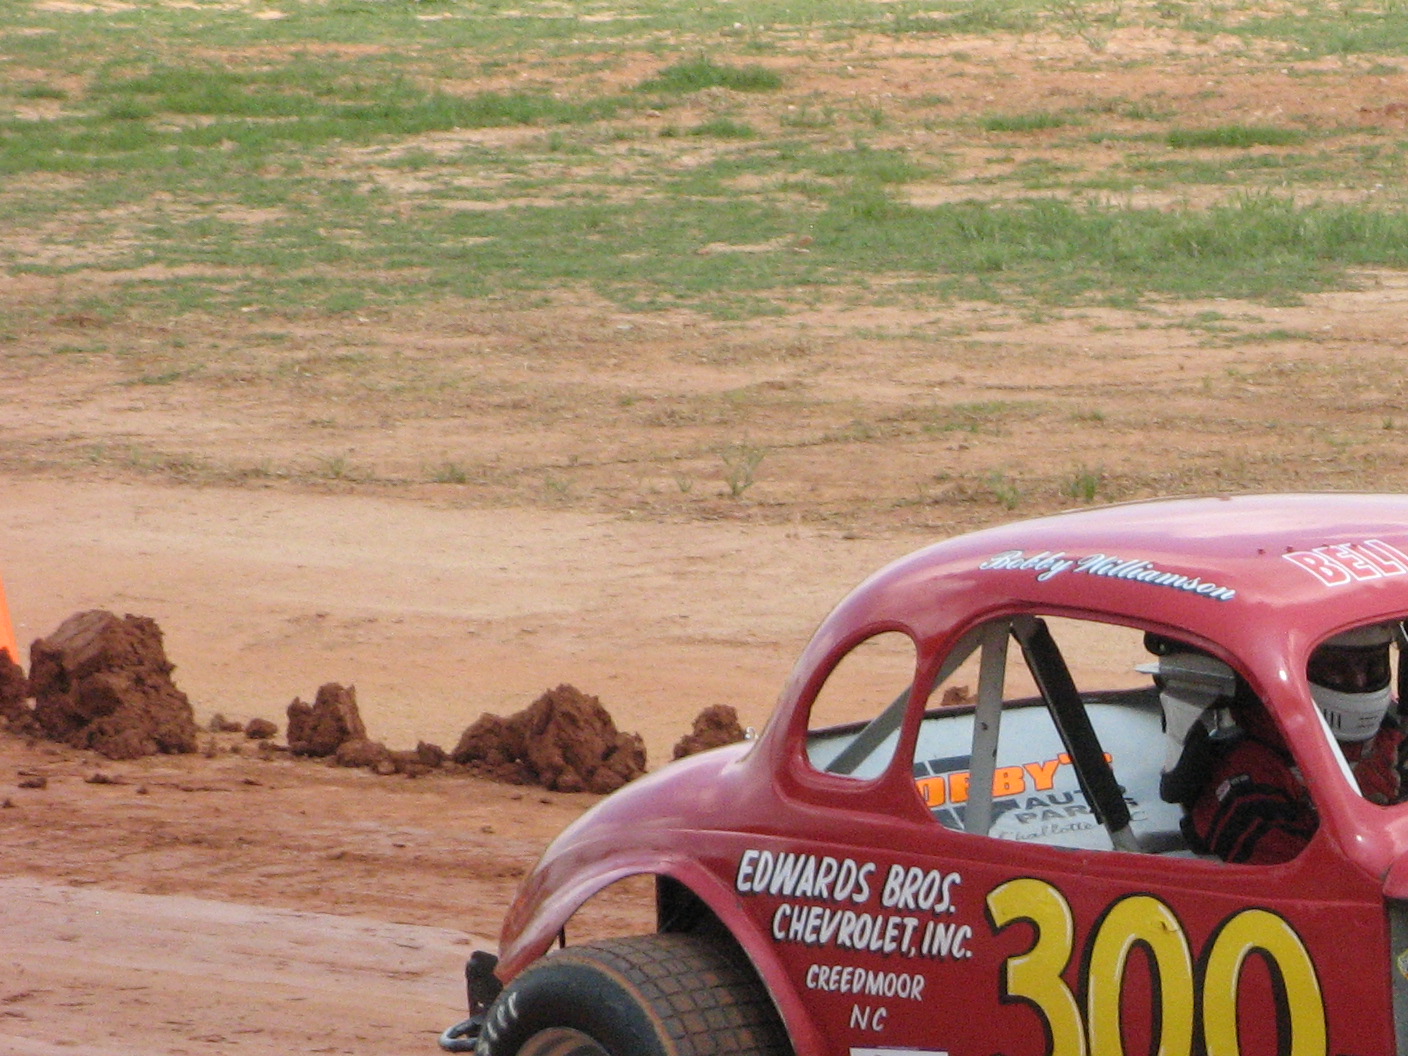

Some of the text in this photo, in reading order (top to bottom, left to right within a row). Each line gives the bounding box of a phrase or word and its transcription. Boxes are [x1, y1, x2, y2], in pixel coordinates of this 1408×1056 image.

[979, 550, 1236, 602] Bobby Williamson
[736, 850, 962, 914] EDWARDS BROS.
[772, 903, 973, 959] CHEVROLET, INC.
[806, 964, 925, 1001] CREEDMOOR
